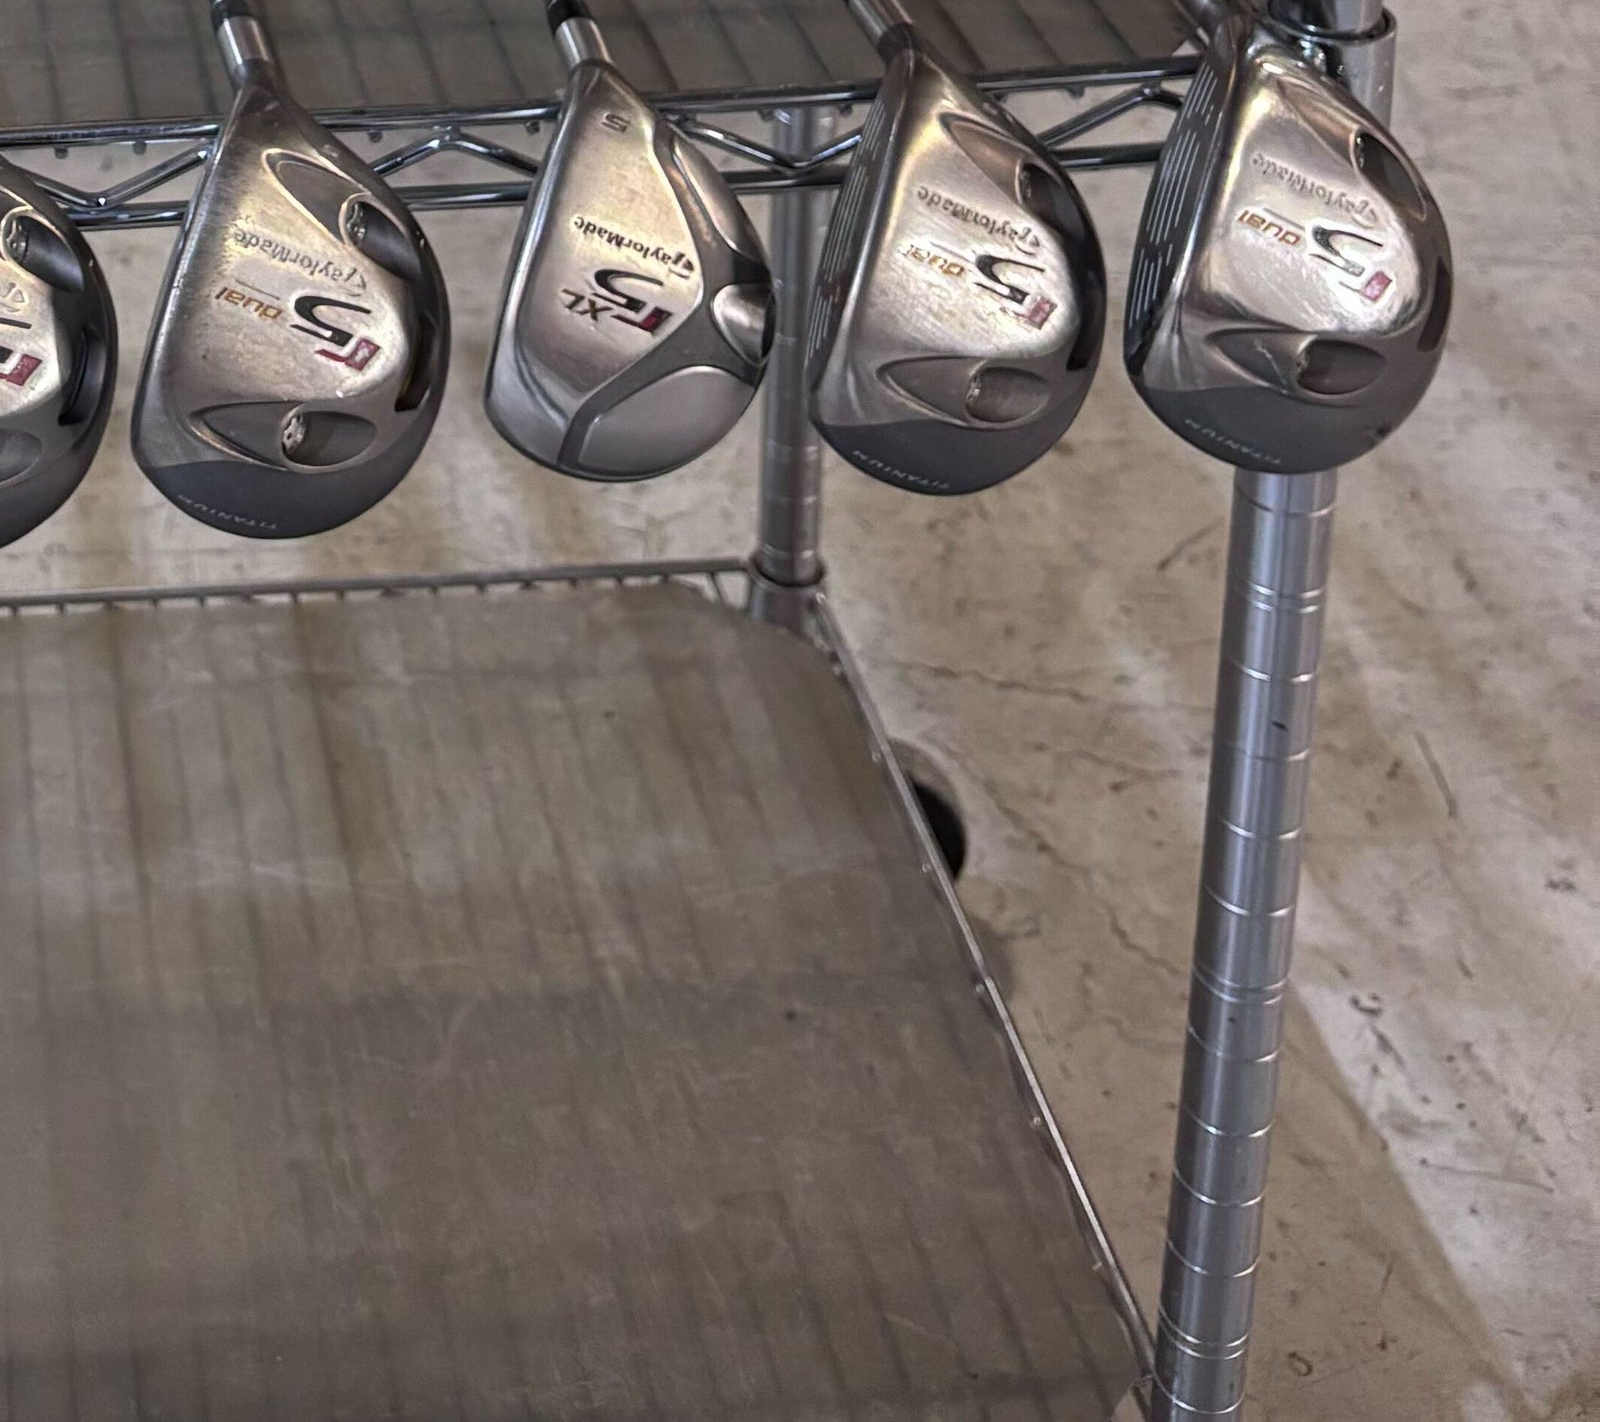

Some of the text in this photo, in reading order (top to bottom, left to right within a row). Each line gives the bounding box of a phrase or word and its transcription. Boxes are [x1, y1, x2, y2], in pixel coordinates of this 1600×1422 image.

[916, 185, 1041, 257] TaylorMade
[1251, 152, 1379, 230] TaylorMade
[572, 214, 696, 281] TaylorMade
[1236, 208, 1302, 246] dual
[234, 229, 368, 298] TaylorMade
[214, 285, 284, 321] dual
[561, 287, 614, 323] XL
